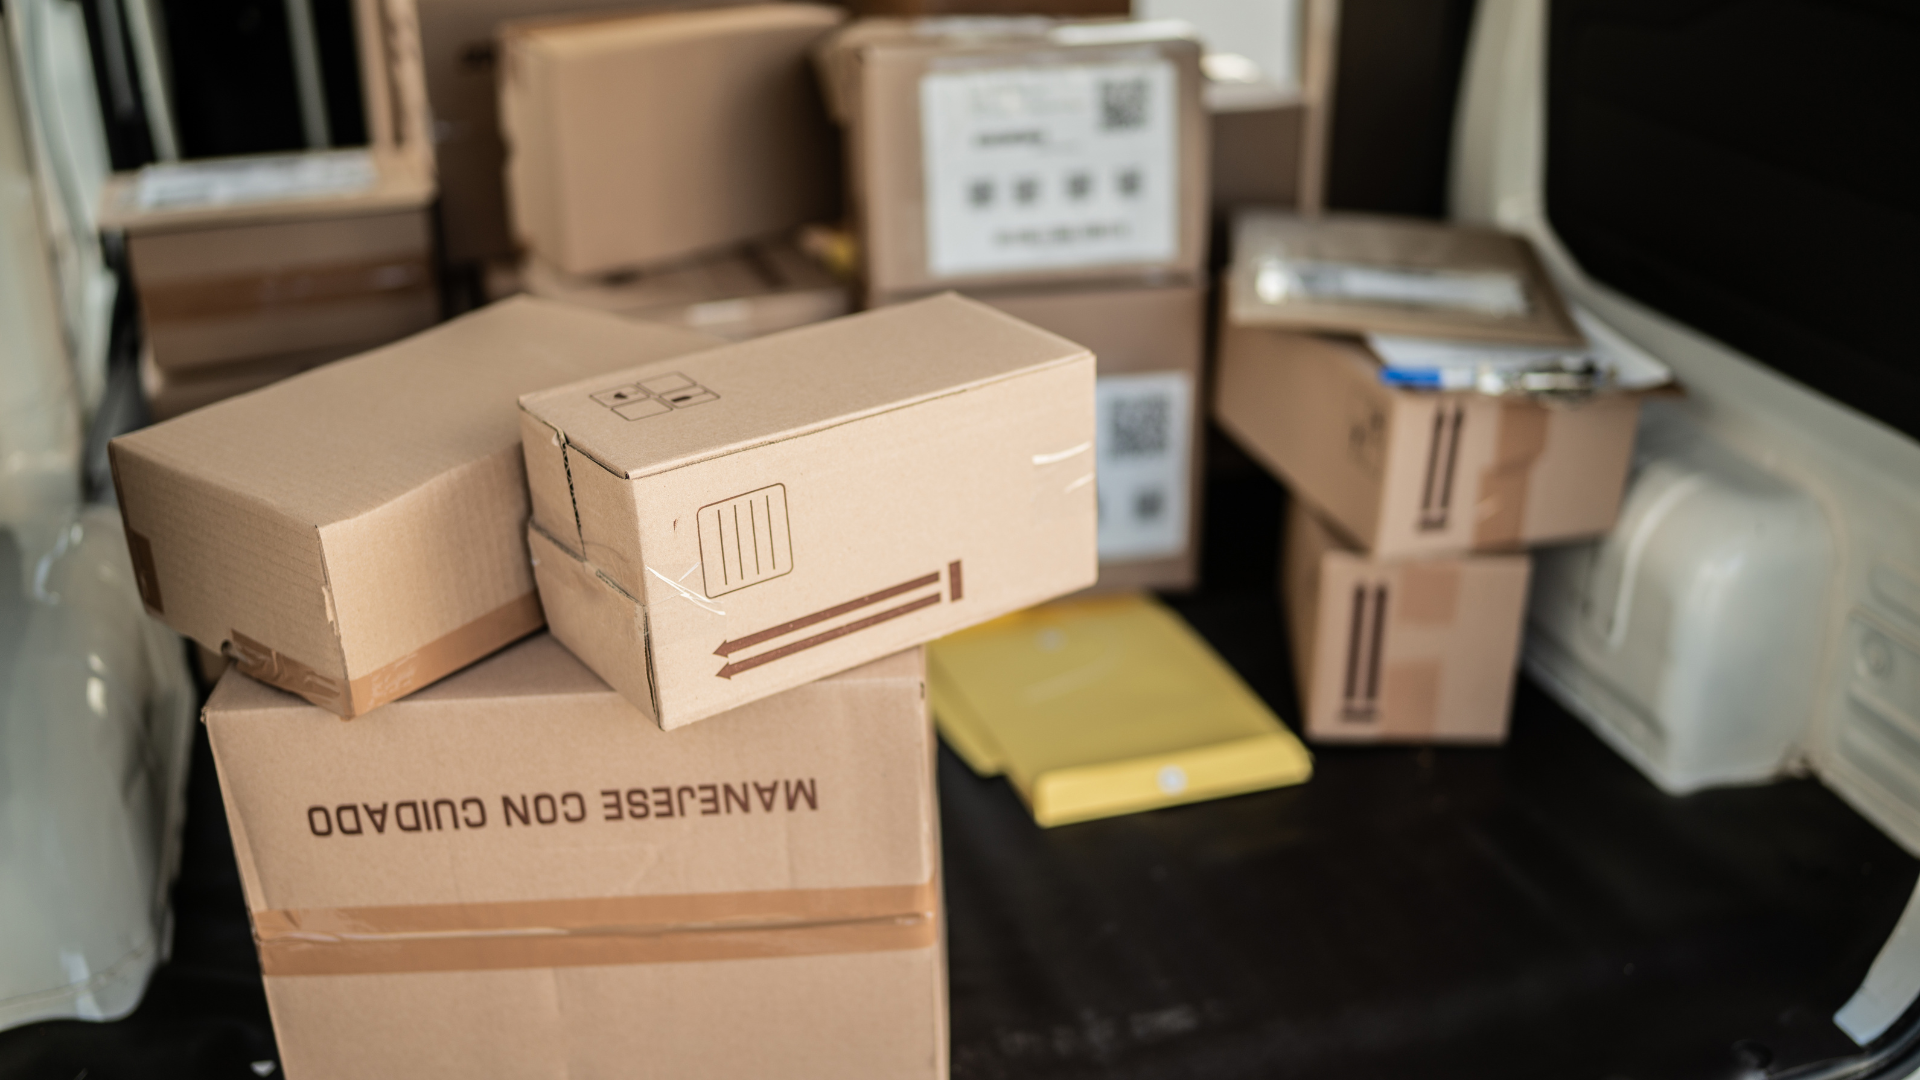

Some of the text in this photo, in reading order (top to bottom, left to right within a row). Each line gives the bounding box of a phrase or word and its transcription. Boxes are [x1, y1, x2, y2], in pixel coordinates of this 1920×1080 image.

[306, 777, 819, 838] MANEJESE CON CUIDADO
